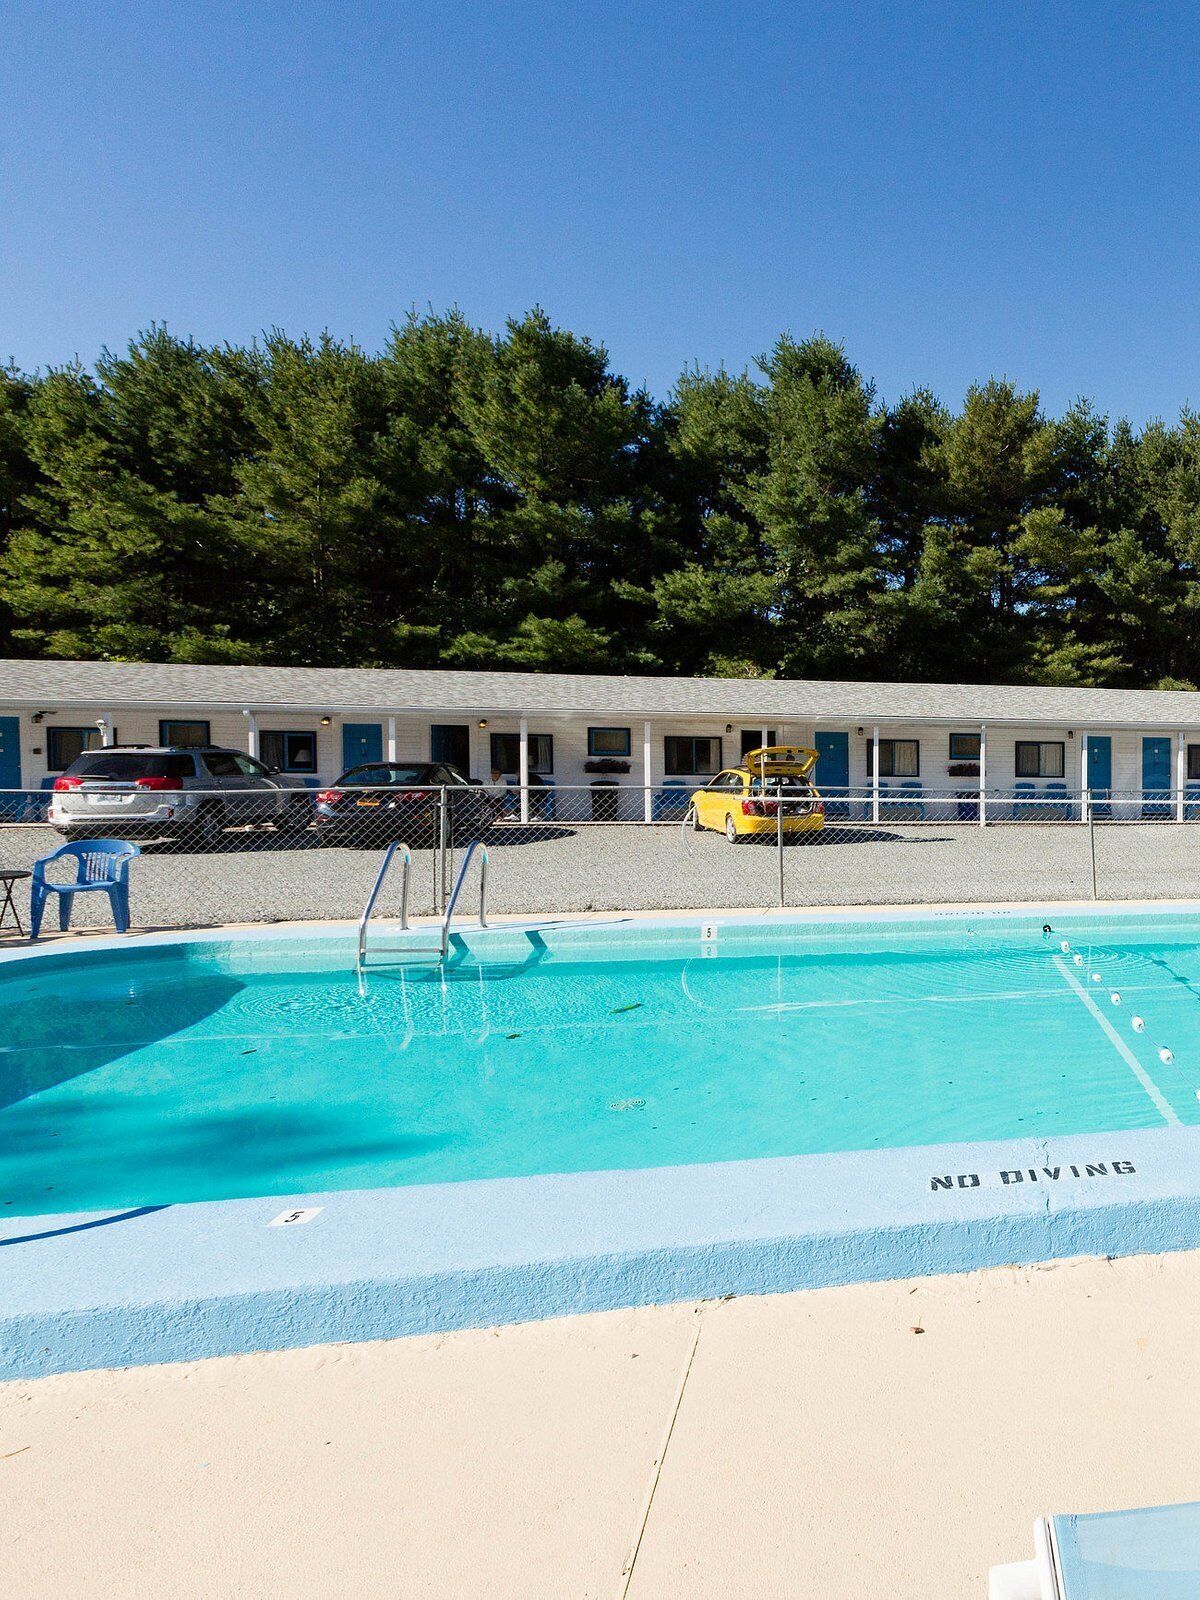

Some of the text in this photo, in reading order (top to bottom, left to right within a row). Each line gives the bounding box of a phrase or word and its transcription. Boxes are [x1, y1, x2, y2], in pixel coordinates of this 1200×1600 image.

[930, 1160, 1137, 1191] NO DIVING
[284, 1210, 305, 1223] 5
